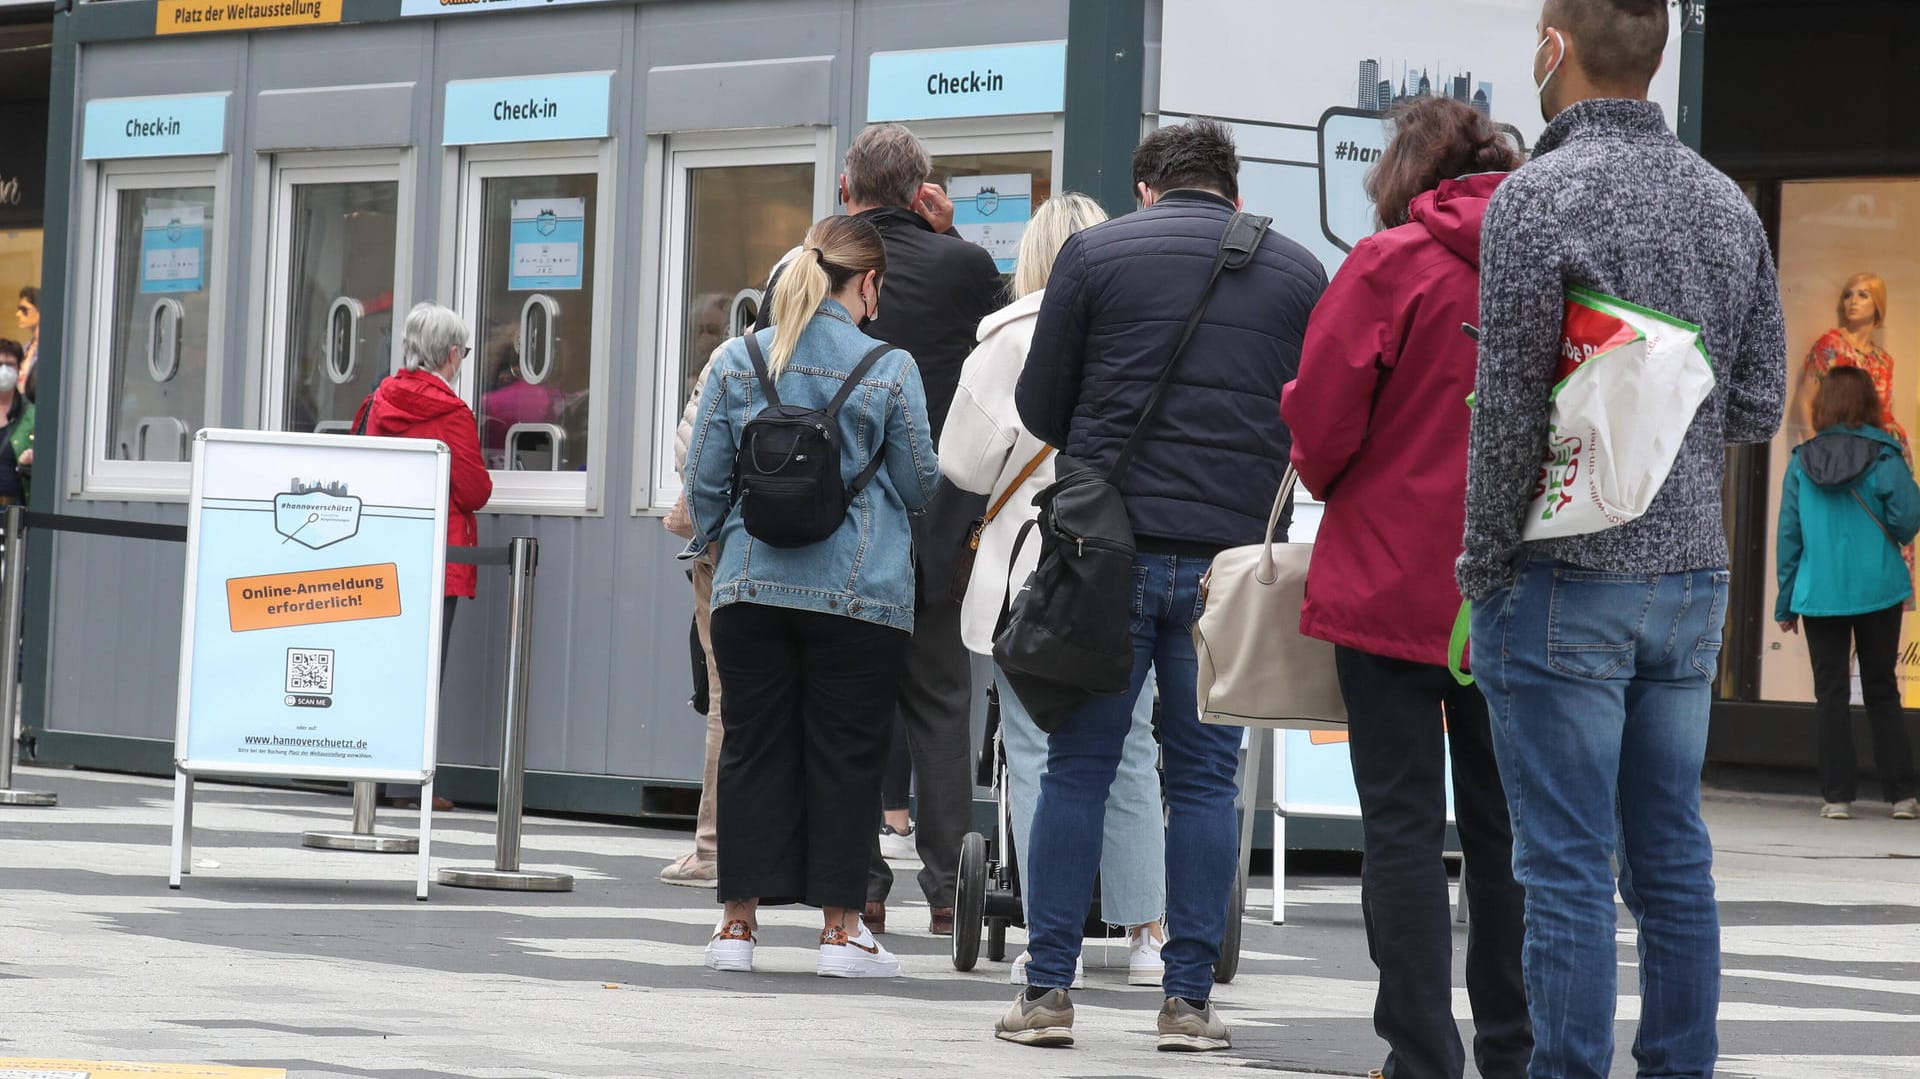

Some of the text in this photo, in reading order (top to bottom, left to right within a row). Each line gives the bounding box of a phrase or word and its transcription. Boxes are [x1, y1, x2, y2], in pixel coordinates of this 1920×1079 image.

[175, 0, 321, 24] Platz der Weltausstellung
[927, 69, 1003, 95] Check-in
[494, 97, 557, 121] Check-in
[126, 116, 180, 137] Check-in
[1335, 141, 1382, 162] #han
[281, 502, 353, 512] #hannoverschützt
[242, 577, 384, 600] Online-Anmeldung
[267, 595, 363, 615] erforderlich!
[245, 735, 368, 749] www.hannoverschuetzt.de
